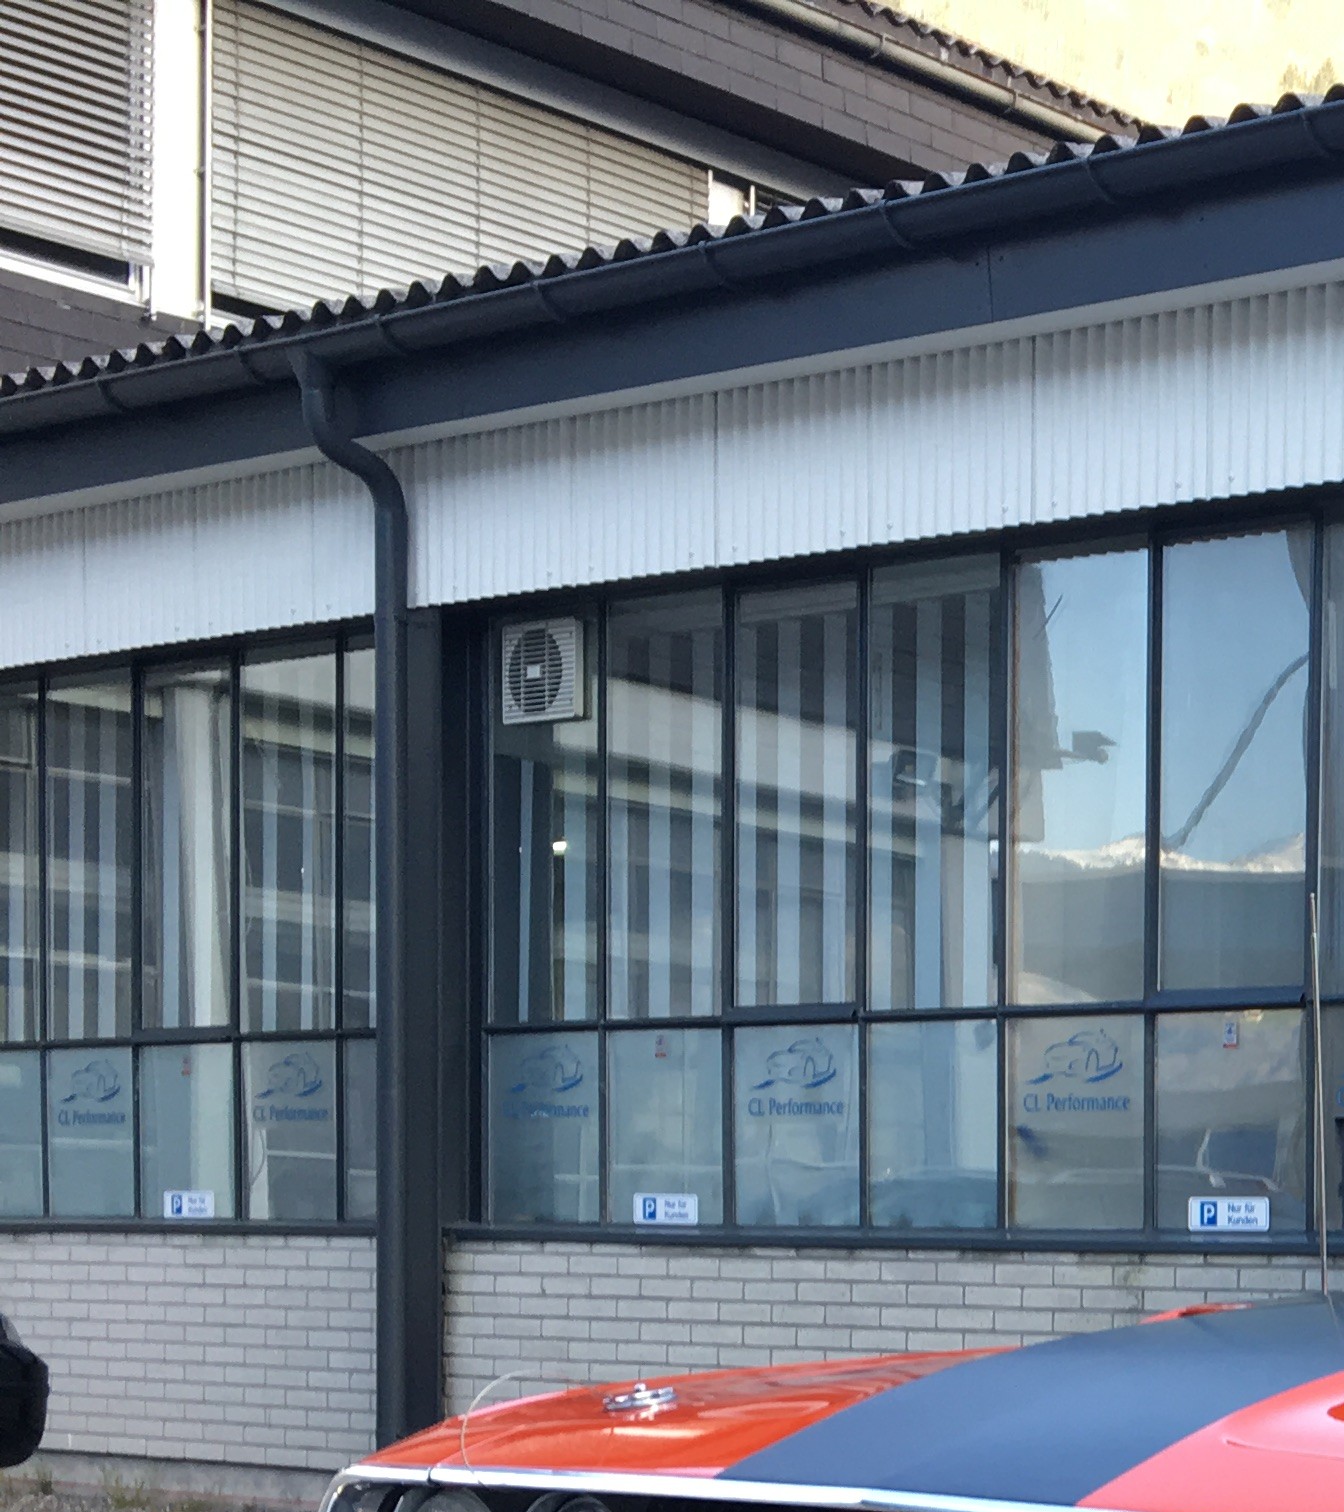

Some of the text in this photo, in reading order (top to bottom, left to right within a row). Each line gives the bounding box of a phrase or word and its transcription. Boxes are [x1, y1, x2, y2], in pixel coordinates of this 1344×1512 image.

[748, 1097, 843, 1116] CL Performance
[1023, 1093, 1130, 1113] CL Performance
